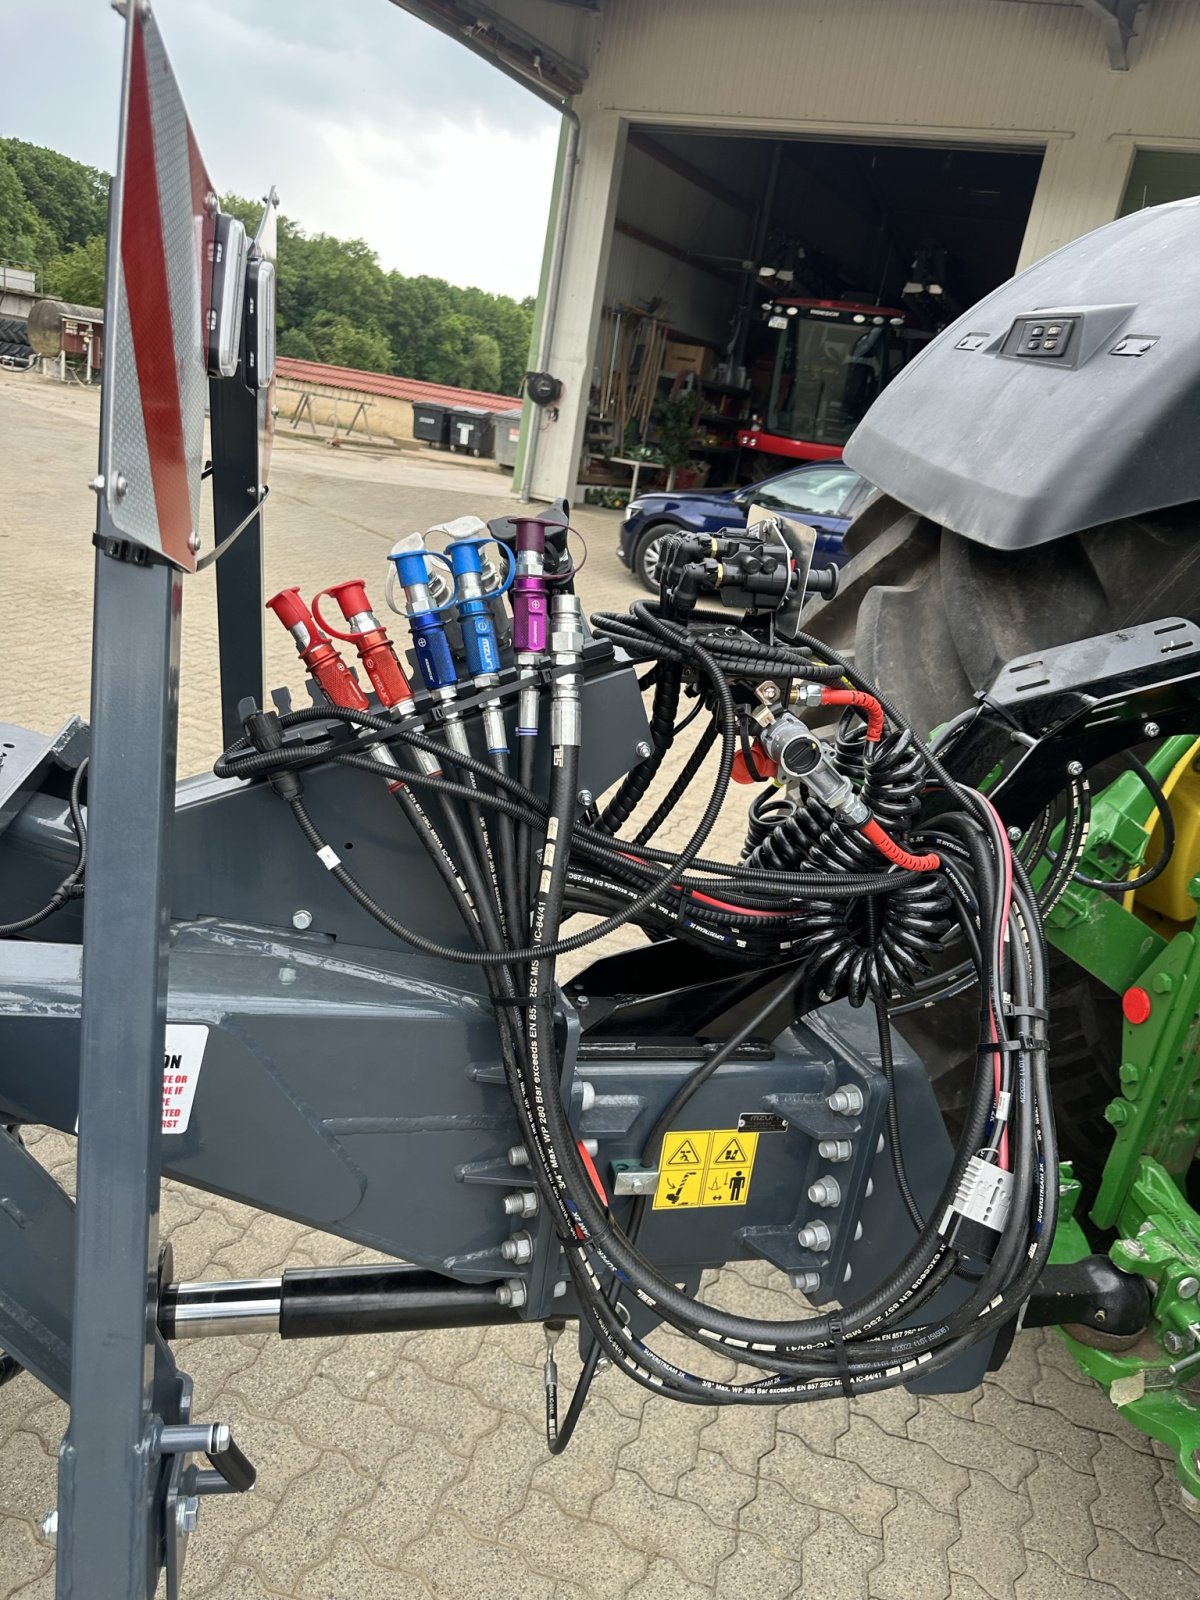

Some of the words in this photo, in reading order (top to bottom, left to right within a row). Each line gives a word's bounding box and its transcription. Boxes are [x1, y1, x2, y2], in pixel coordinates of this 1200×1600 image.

[534, 901, 546, 942] IC-84/41
[529, 1023, 537, 1038] EN
[531, 1041, 541, 1083] exceeds
[175, 1075, 188, 1083] OR
[174, 1086, 184, 1095] IF
[535, 1085, 543, 1103] Bar
[537, 1106, 547, 1124] 280
[541, 1126, 551, 1143] WP
[548, 1145, 559, 1168] Max.
[912, 1253, 940, 1289] exceeds
[899, 1290, 913, 1303] EN
[884, 1302, 900, 1317] 857
[863, 1315, 883, 1330] 2SC
[643, 1348, 678, 1375] SUPERSTREAM
[702, 1380, 715, 1388] 3/8"
[715, 1384, 731, 1392] Max.
[769, 1386, 795, 1394] exceeds
[807, 1381, 819, 1390] 857
[819, 1380, 833, 1388] 2SC
[856, 1372, 882, 1383] IC-84/41
